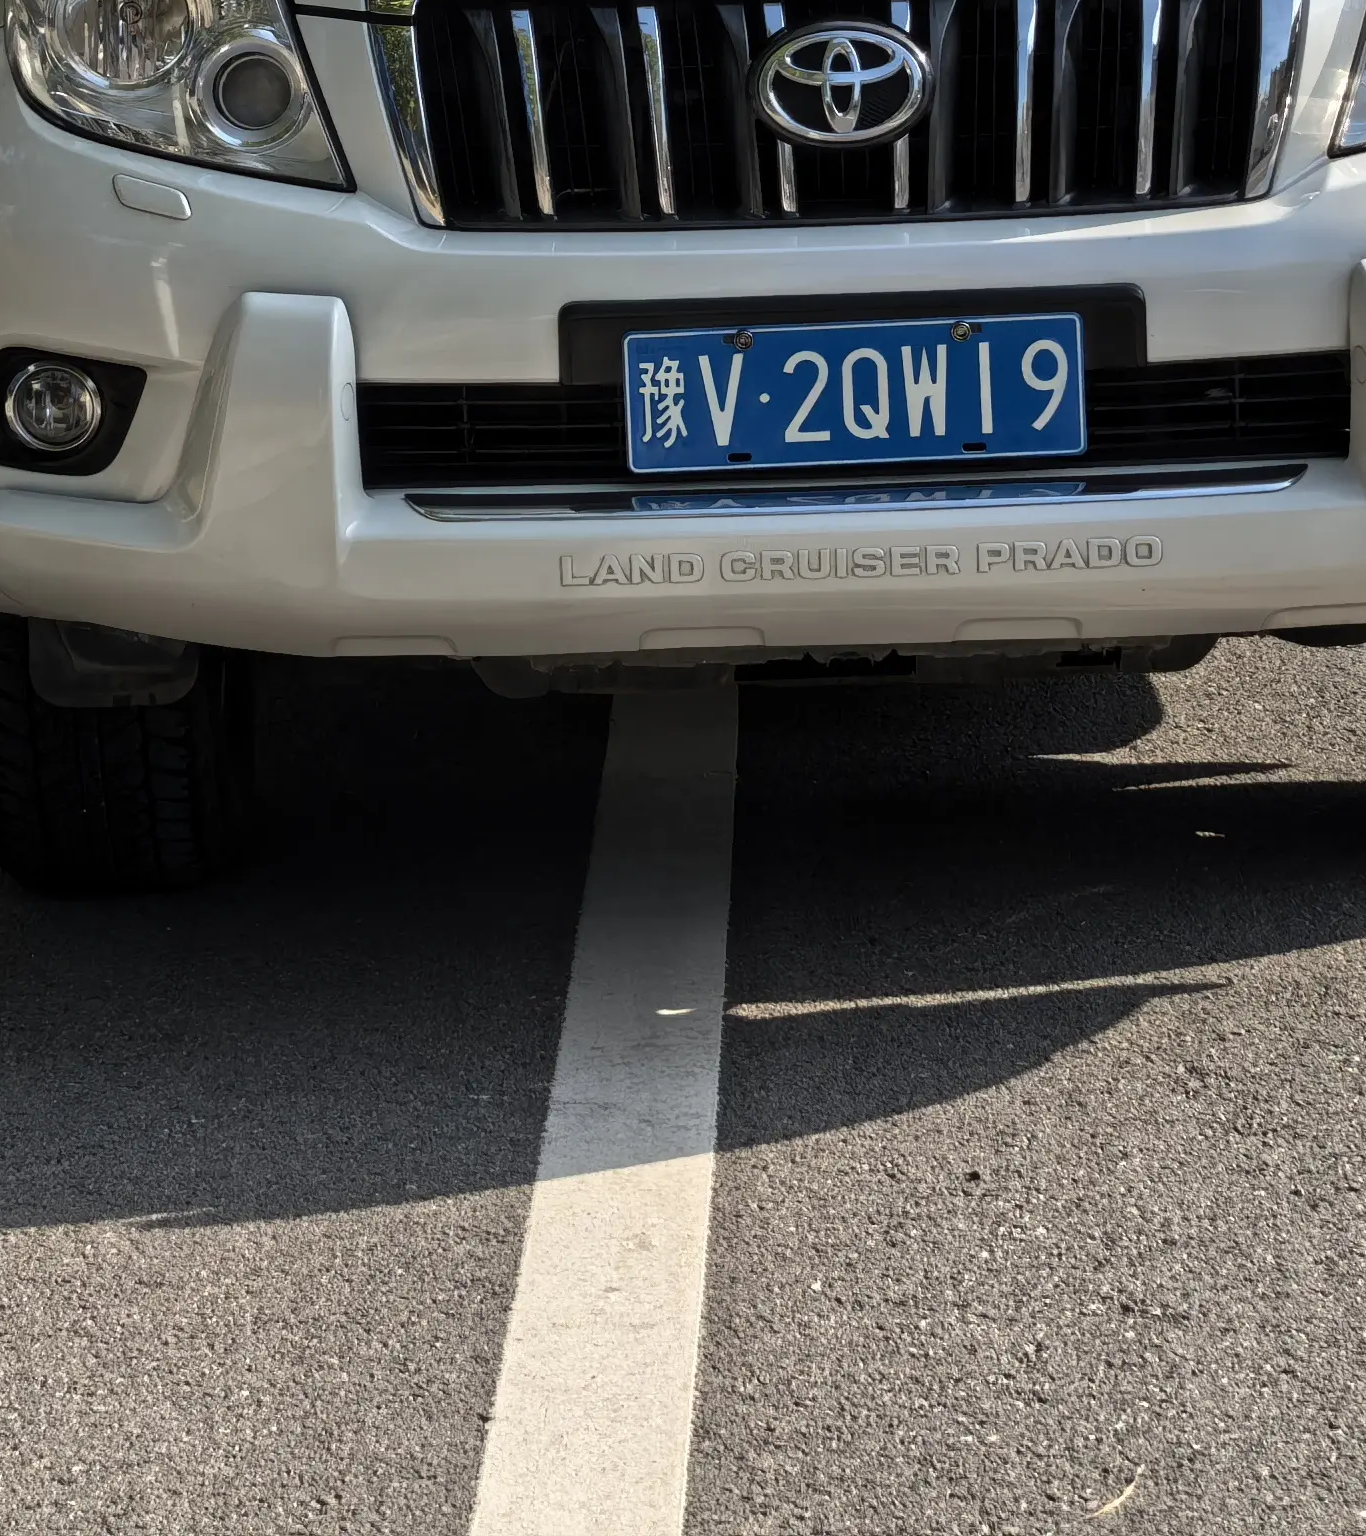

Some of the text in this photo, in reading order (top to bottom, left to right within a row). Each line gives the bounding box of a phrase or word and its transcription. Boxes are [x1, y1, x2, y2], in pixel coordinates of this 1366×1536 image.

[559, 534, 1164, 587] LAND CRUISER PRADO
